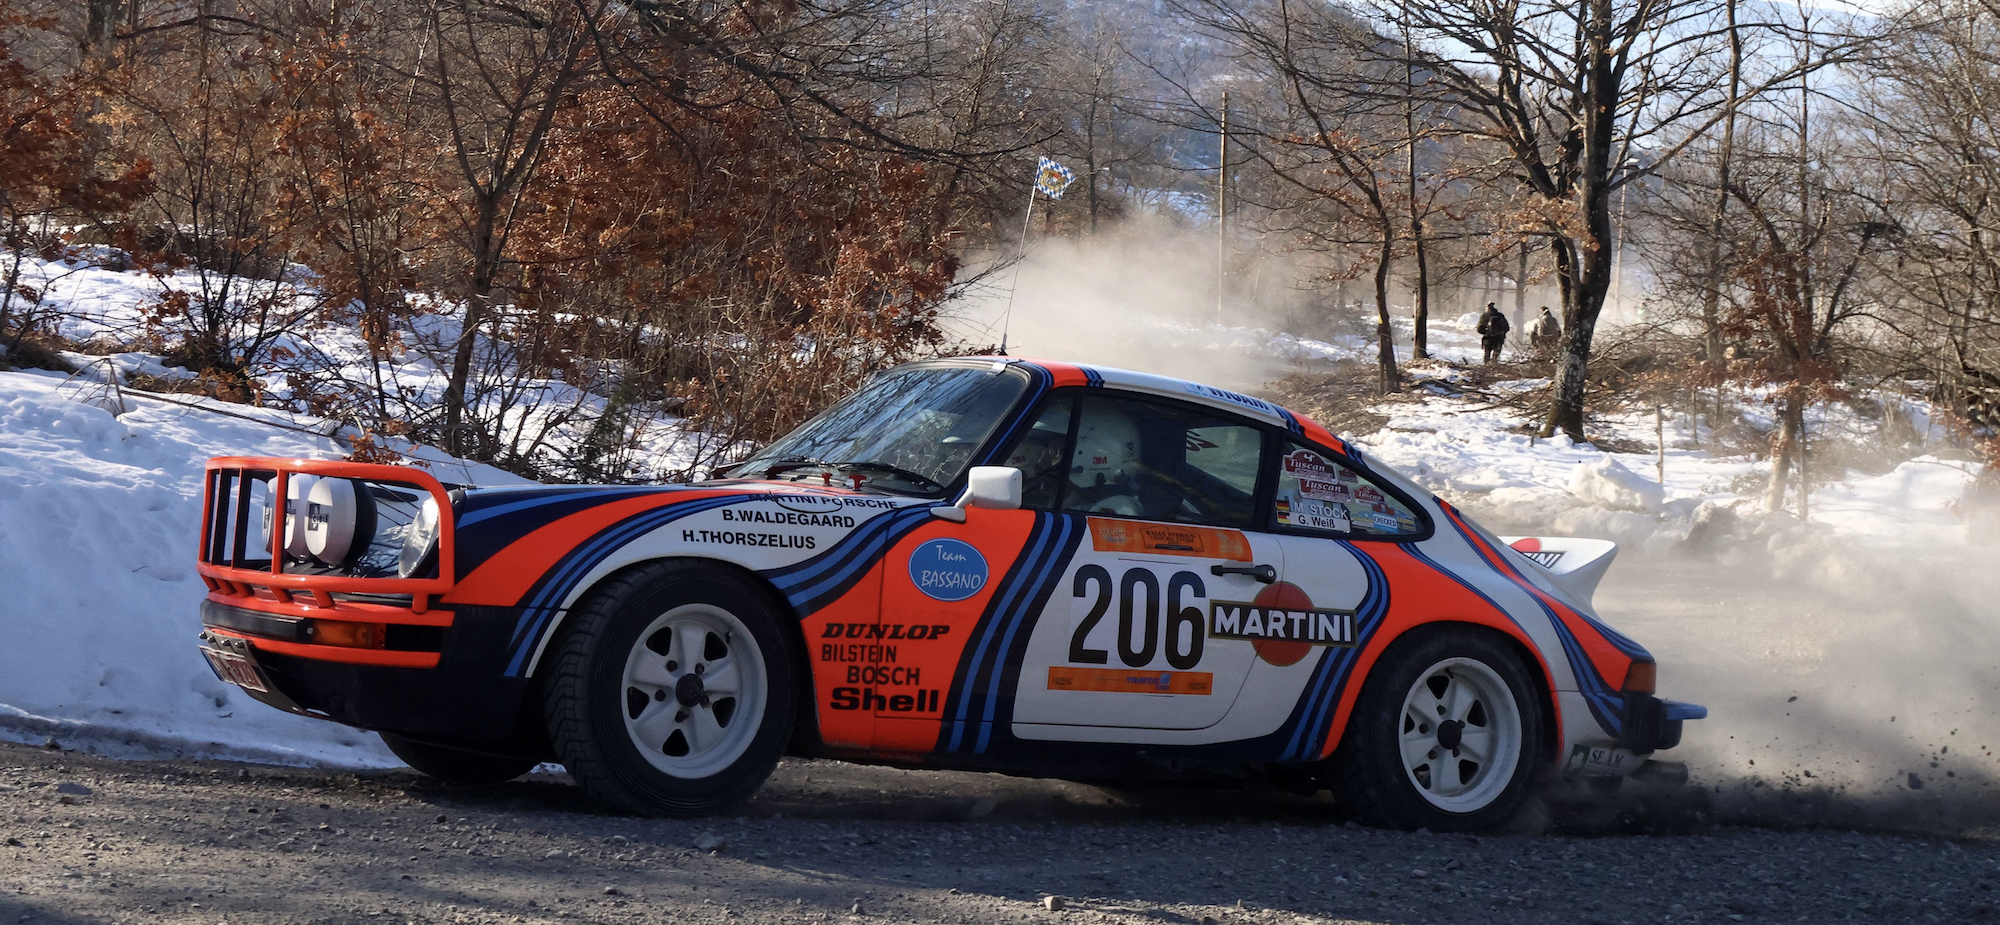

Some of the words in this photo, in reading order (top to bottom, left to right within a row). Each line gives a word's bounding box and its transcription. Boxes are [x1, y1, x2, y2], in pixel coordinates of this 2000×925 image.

[1092, 456, 1108, 465] 3M
[1289, 458, 1326, 472] Tuscan
[1305, 479, 1341, 493] Tuscan
[750, 493, 818, 505] MARTINI
[822, 496, 899, 511] PORSCHE
[1294, 502, 1307, 515] M.
[1309, 504, 1349, 520] STOCK
[722, 509, 855, 528] B.WALDEGAARD
[1298, 515, 1309, 525] G.
[1312, 516, 1336, 529] Weiß
[1374, 515, 1397, 527] CHECKED
[682, 529, 816, 549] H.THORSZELIUS
[936, 545, 967, 562] Team
[920, 569, 982, 590] BASSANO
[1068, 563, 1206, 670] 206
[1214, 605, 1352, 642] MARTINI
[820, 622, 951, 640] DUNLOP
[821, 643, 897, 663] BILSTEIN
[846, 665, 921, 686] BOSCH
[1126, 676, 1159, 685] TRATOS
[830, 686, 940, 712] Shell
